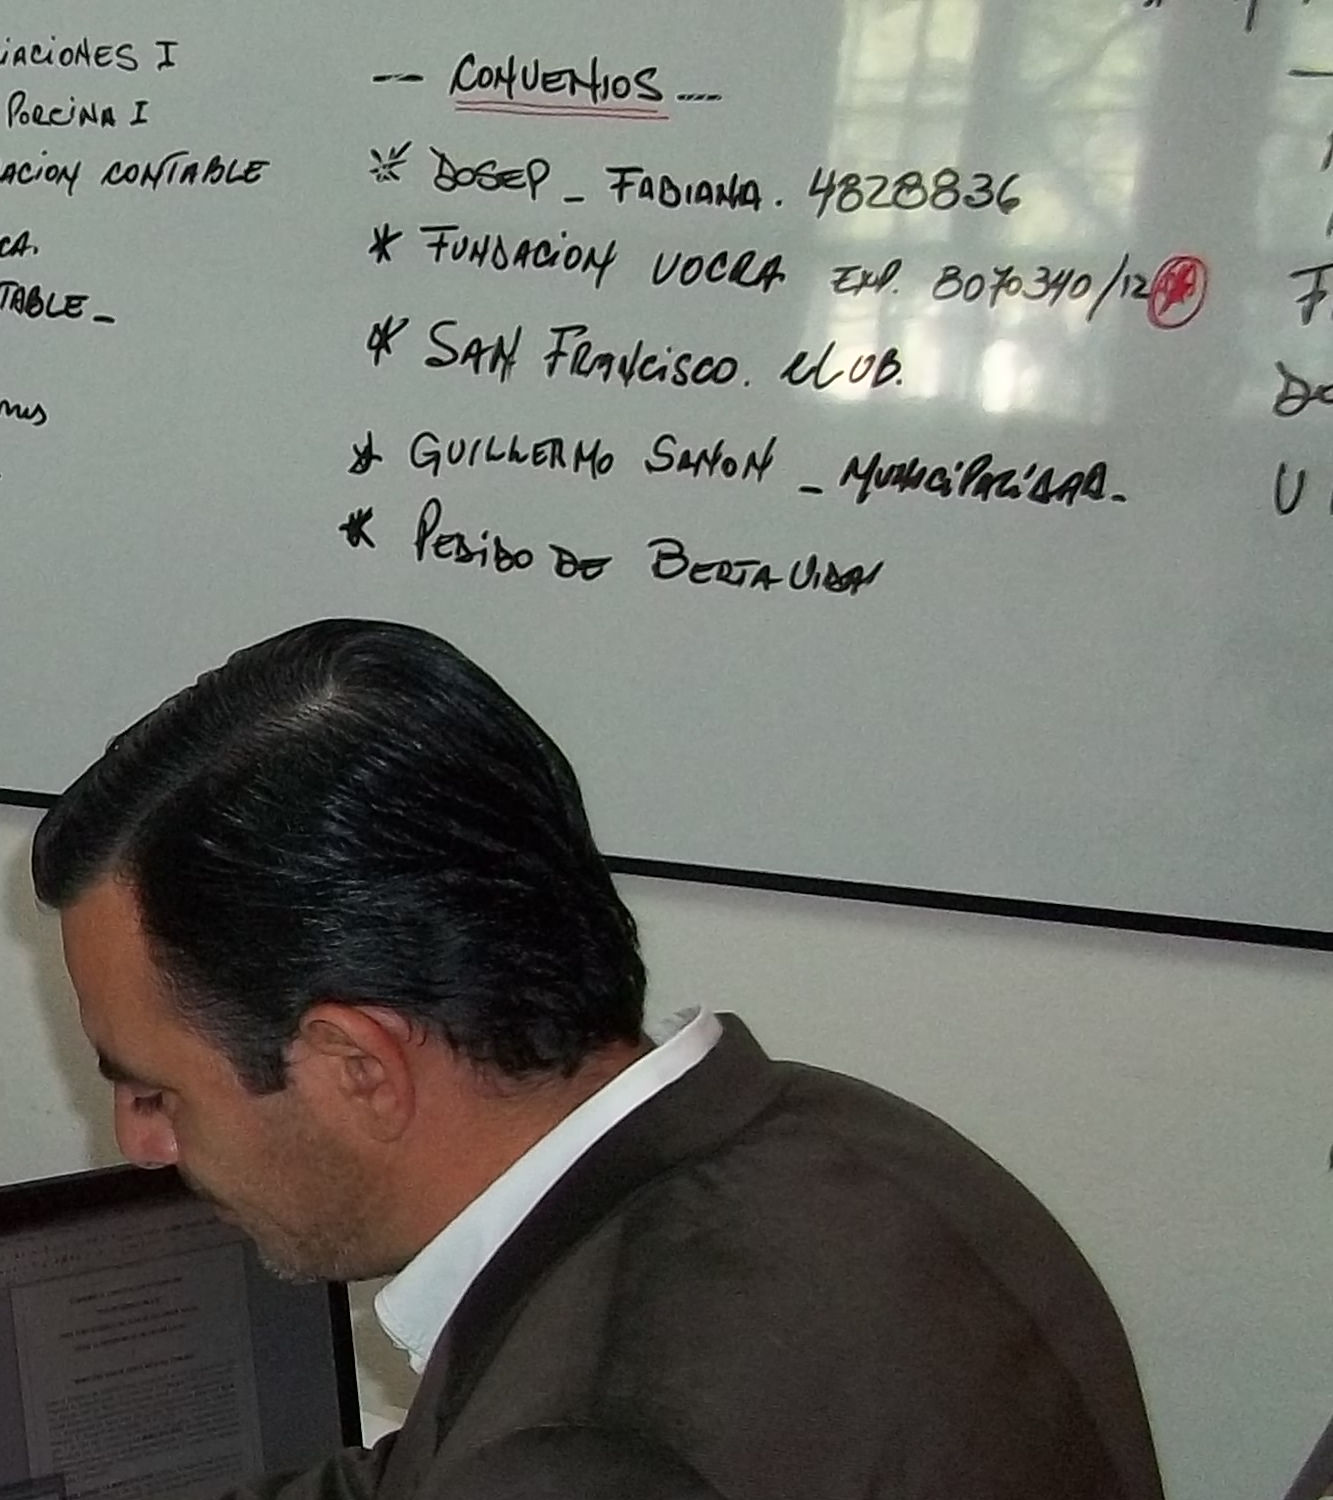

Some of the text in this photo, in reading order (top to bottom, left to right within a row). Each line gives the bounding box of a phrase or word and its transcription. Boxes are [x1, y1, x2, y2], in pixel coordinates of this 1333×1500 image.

[154, 40, 180, 72] I
[448, 52, 664, 104] CONVENIOS
[7, 91, 117, 129] PORCINA
[129, 99, 150, 127] I
[100, 150, 271, 192] CONTABLE
[808, 166, 1022, 220] 4828836
[419, 224, 619, 290] FUNDACION
[424, 321, 523, 384] SAN
[409, 430, 615, 481] GUILLERMO
[413, 497, 534, 574] PEDIDO
[646, 537, 783, 592] BERTA
